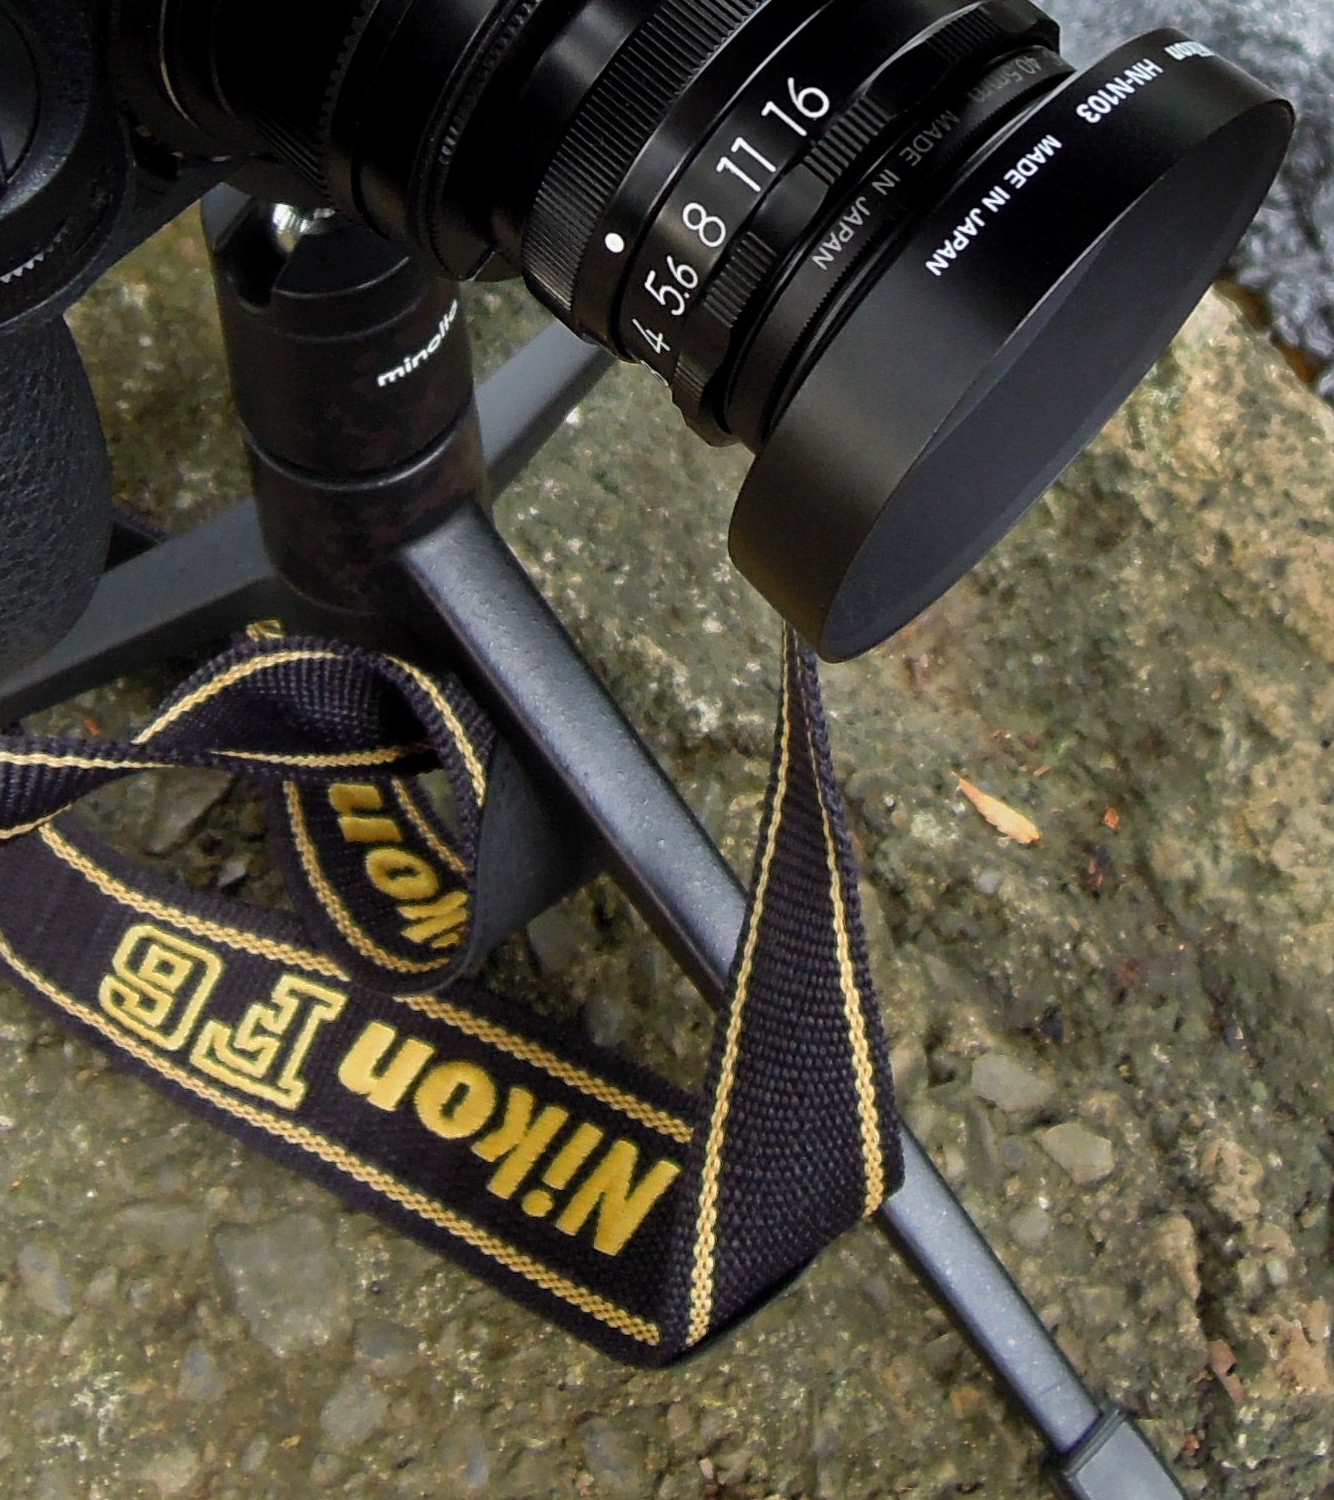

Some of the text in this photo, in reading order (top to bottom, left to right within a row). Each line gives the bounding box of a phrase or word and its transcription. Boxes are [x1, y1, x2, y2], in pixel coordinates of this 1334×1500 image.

[761, 76, 830, 138] 16
[1075, 57, 1164, 125] HN-N103
[715, 135, 777, 193] 11
[810, 109, 960, 271] MADE IN JAPAN
[681, 202, 727, 249] 8
[924, 133, 1064, 277] MADE IN JAPAN
[644, 255, 699, 316] 5.6
[376, 298, 458, 388] minolta
[631, 318, 671, 355] 4
[97, 923, 680, 1257] Nikon F6
